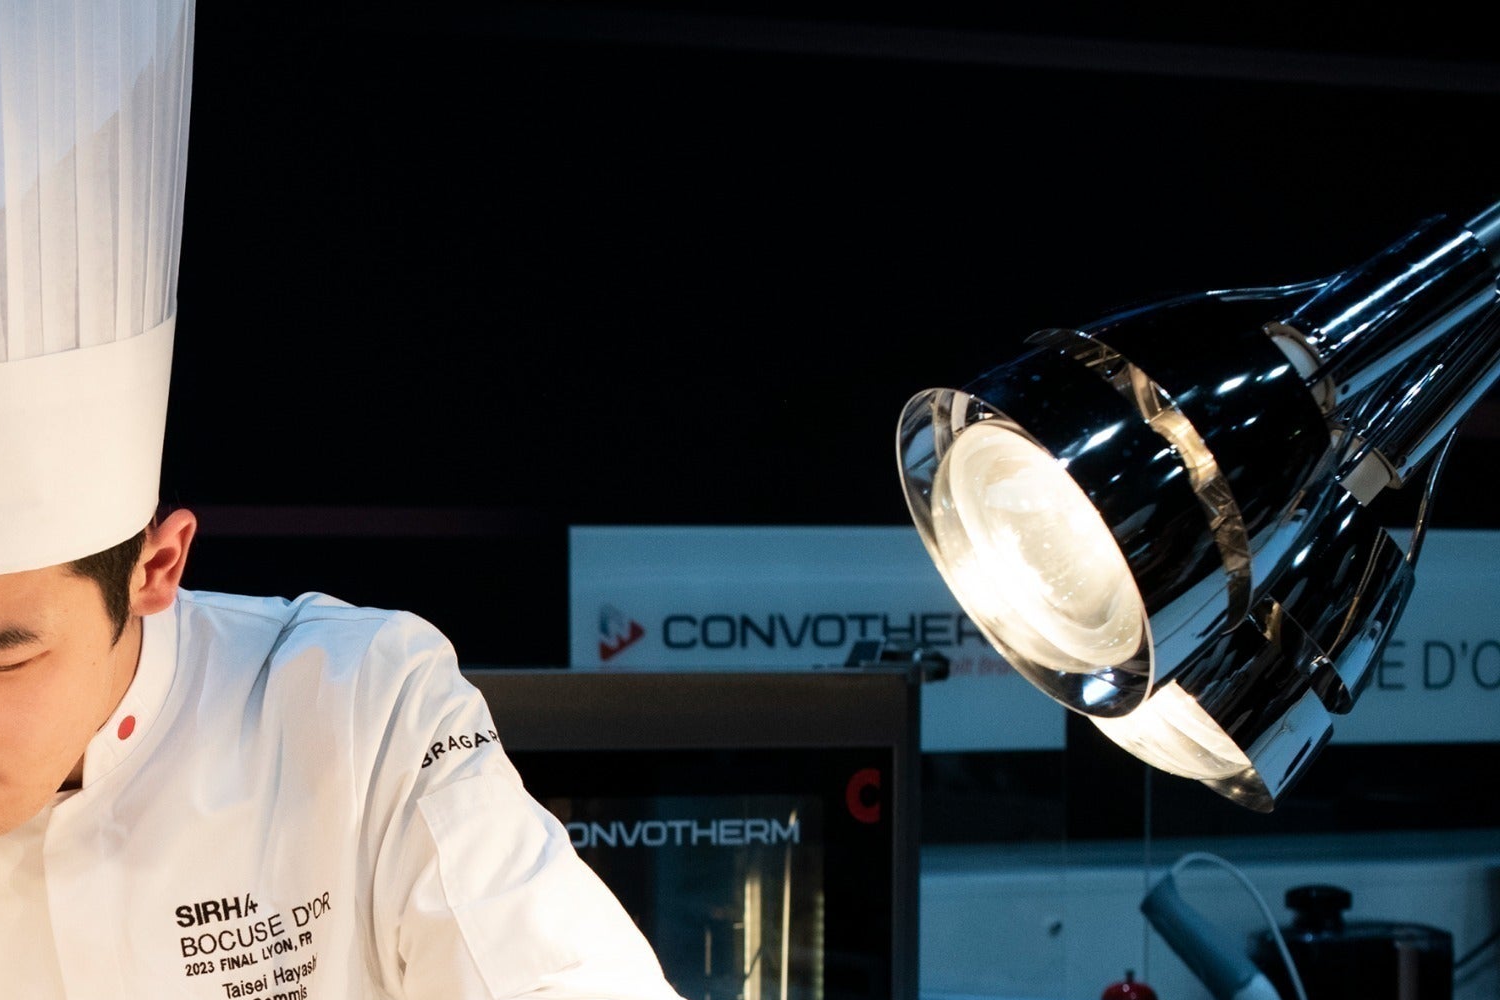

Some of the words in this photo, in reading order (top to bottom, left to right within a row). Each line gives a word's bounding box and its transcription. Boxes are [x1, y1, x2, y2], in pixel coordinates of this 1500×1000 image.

[180, 913, 286, 958] BOCUSE
[291, 891, 332, 928] D'OR
[185, 961, 215, 977] 2023
[220, 952, 258, 972] FINAL
[262, 937, 298, 961] LYON,
[298, 930, 313, 947] FR
[222, 974, 268, 999] Taisei
